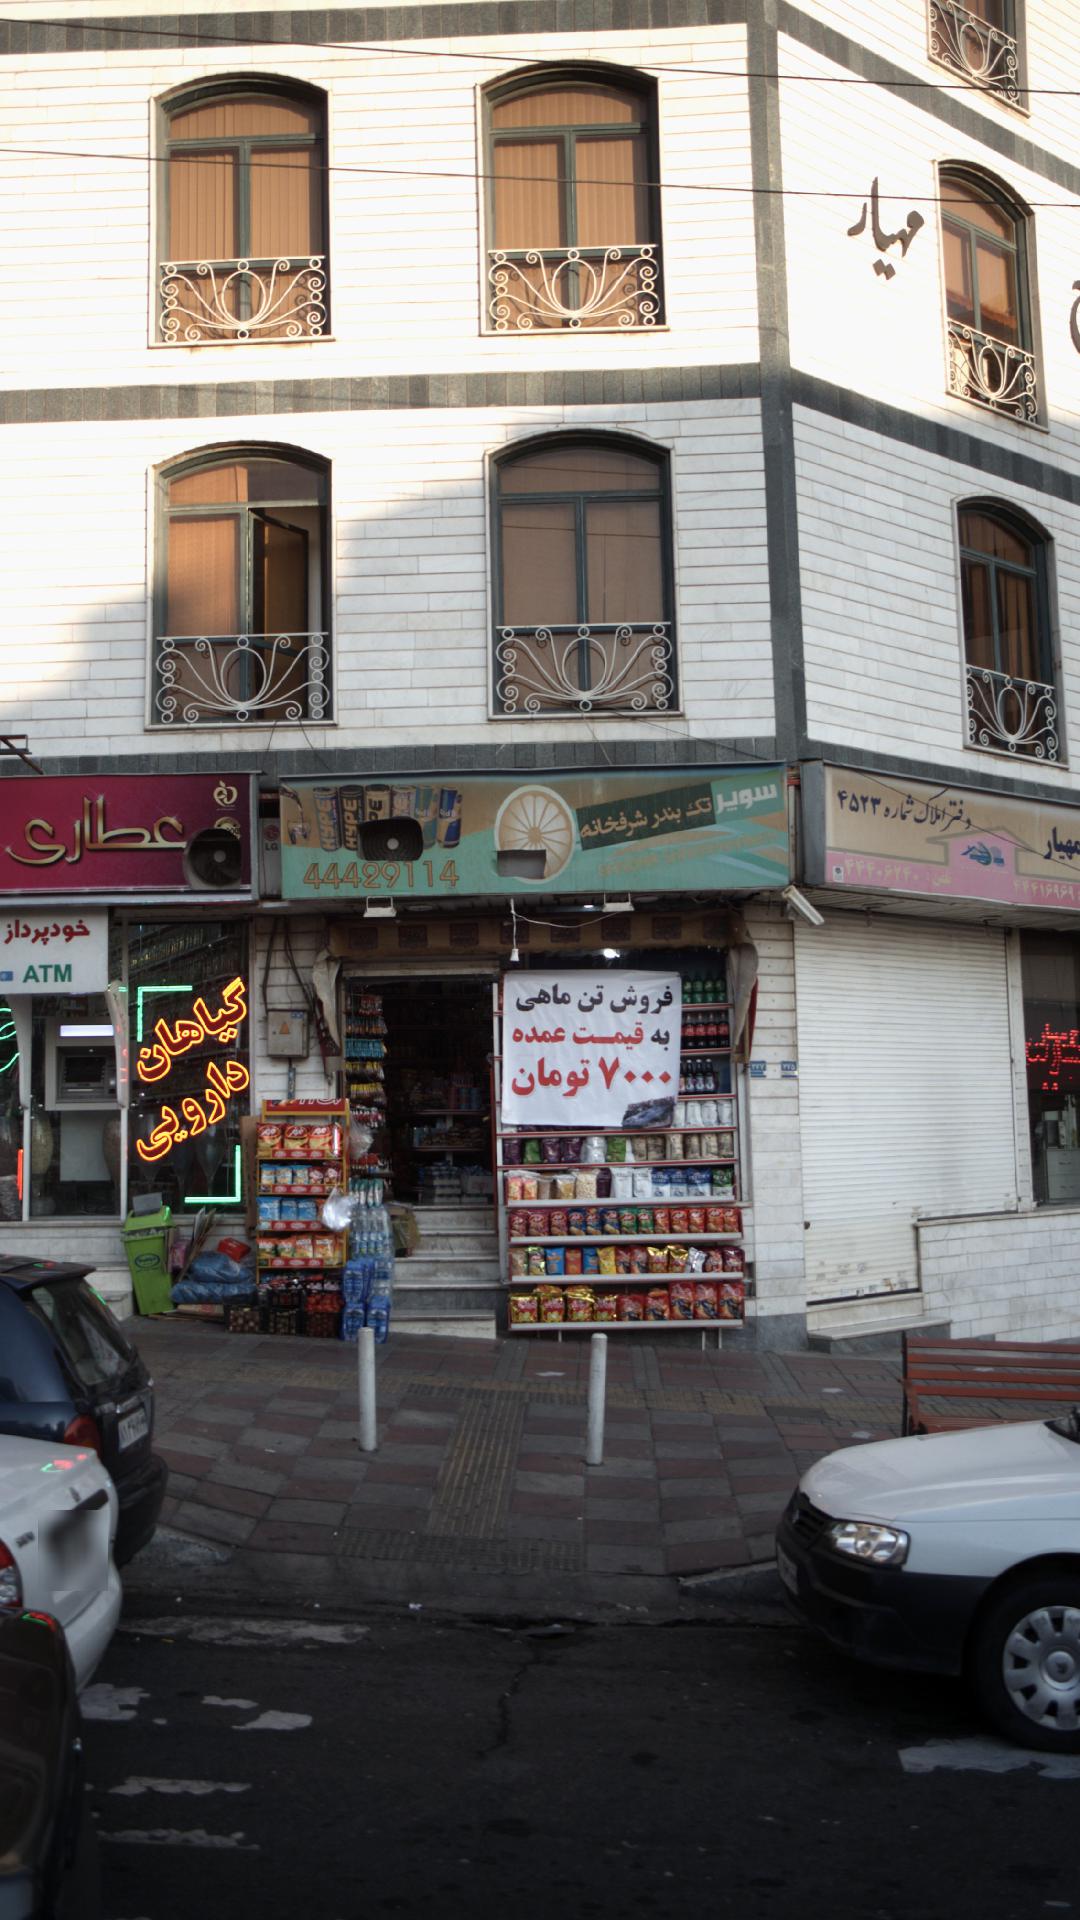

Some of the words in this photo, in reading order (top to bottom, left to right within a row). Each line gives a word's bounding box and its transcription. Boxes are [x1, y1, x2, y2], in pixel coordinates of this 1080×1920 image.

[847, 176, 925, 280] مهیار
[686, 797, 712, 817] تک
[837, 789, 881, 816] ۴۵۲۳
[883, 794, 915, 823] شماره
[913, 787, 949, 826] املاک
[939, 799, 972, 832] دفتر
[5, 794, 188, 866] عطاری
[319, 798, 339, 850] HYPE
[343, 798, 359, 850] HYPE
[580, 808, 648, 839] شرفخانه
[651, 806, 681, 829] بندر
[303, 859, 460, 889] 44429114
[4, 918, 90, 945] خودپرداز
[22, 963, 73, 983] ATM
[516, 983, 572, 1011] ماهی
[577, 985, 604, 1013] تن
[610, 985, 674, 1014] فروش
[137, 977, 248, 1082] گیاهان
[512, 1026, 566, 1044] عمده
[572, 1021, 645, 1050] قیمت
[650, 1028, 671, 1051] به
[511, 1056, 590, 1097] تومان
[598, 1056, 672, 1090] ۷۰۰۰
[136, 1061, 250, 1161] دارویی
